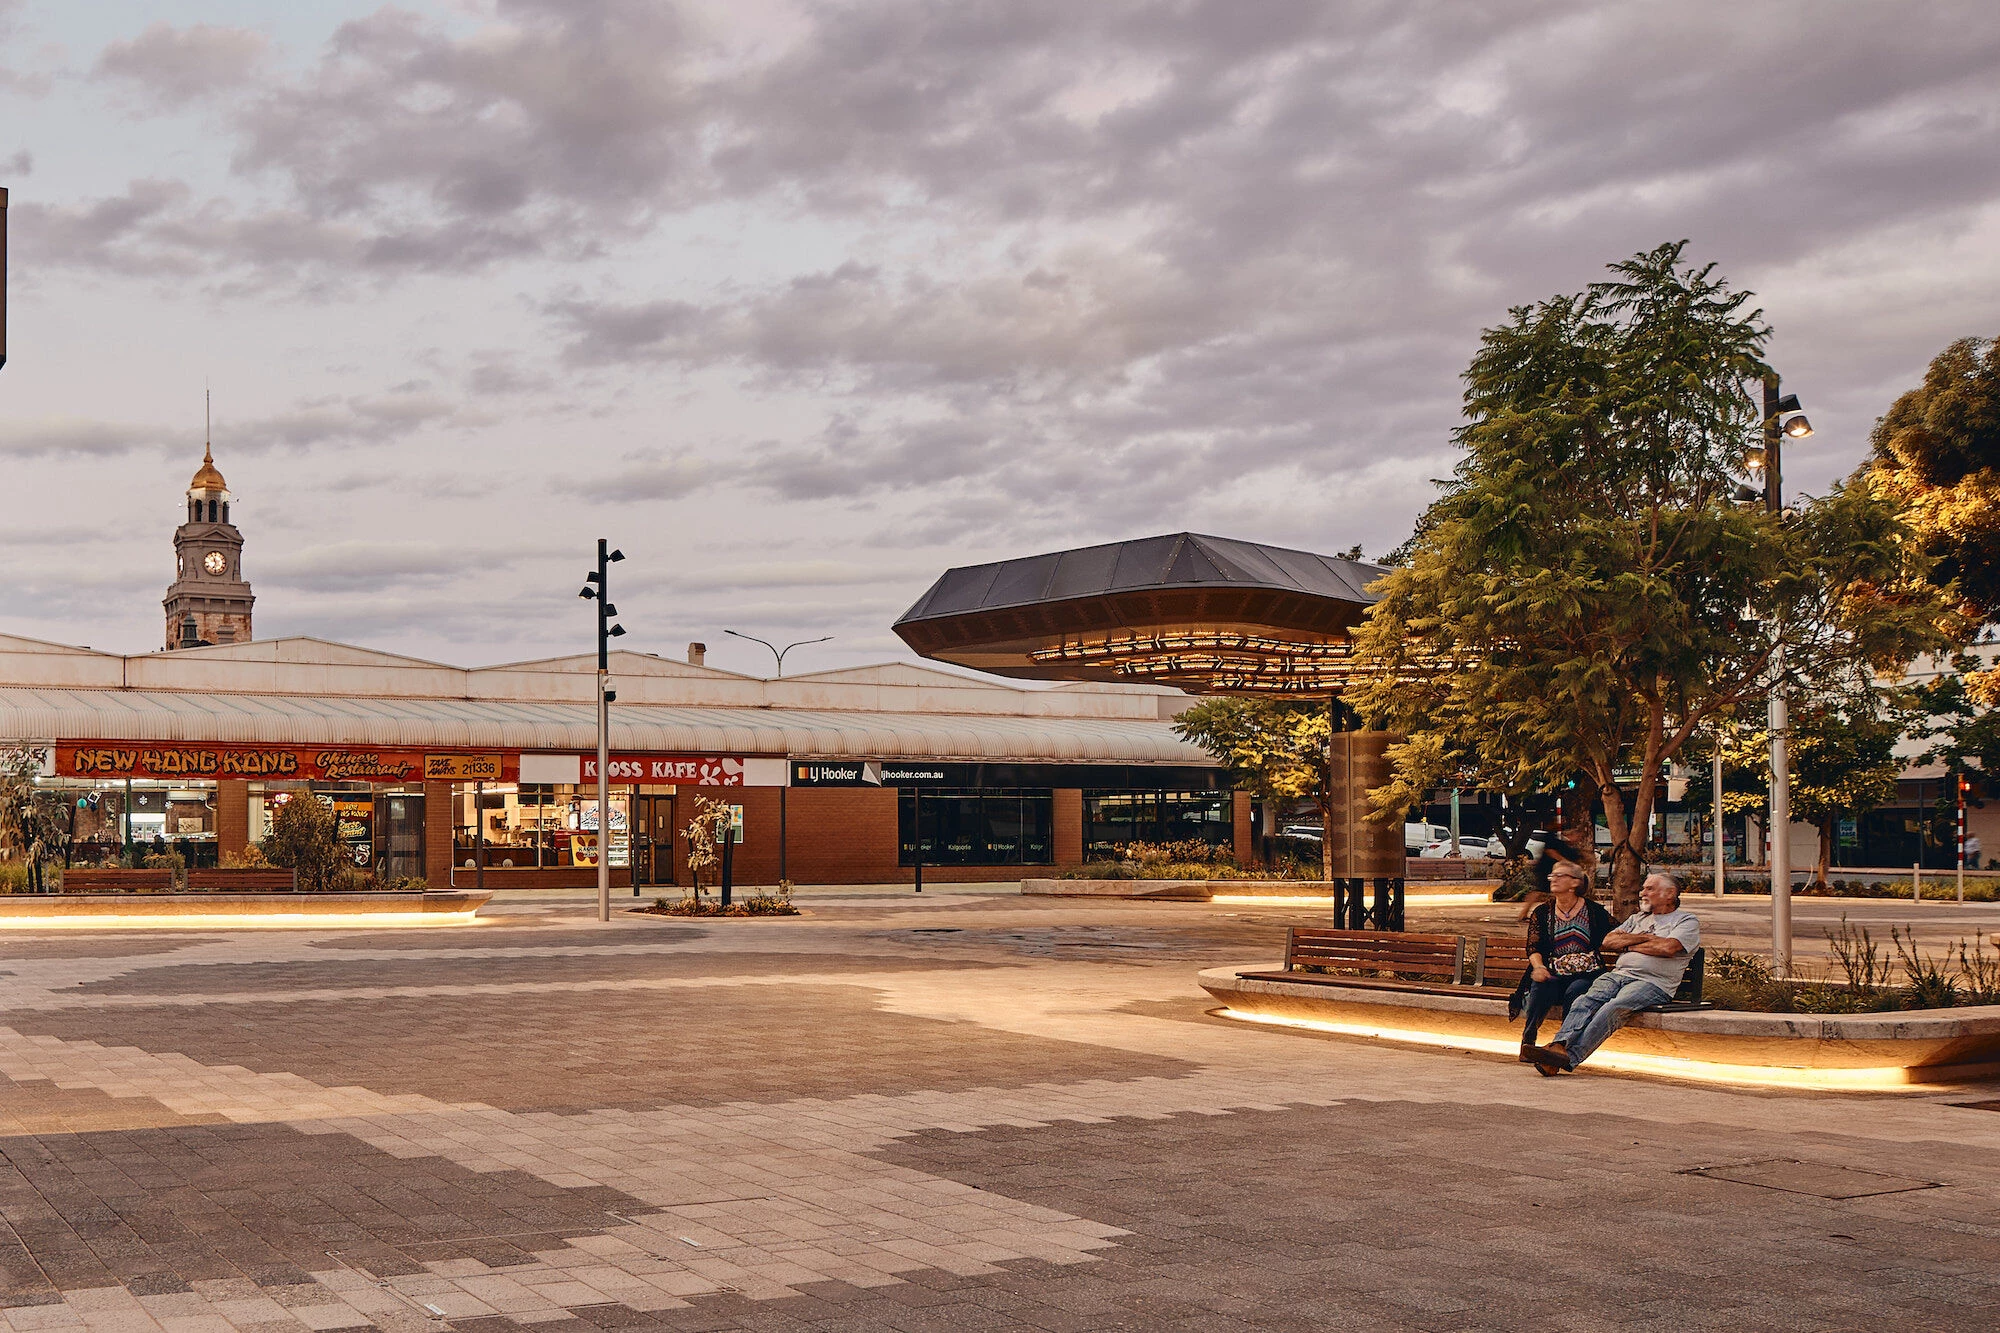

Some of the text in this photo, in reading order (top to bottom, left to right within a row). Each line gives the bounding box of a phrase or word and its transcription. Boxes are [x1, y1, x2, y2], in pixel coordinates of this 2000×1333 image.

[75, 749, 299, 774] NEW HONG KONG
[315, 751, 379, 768] Chinese
[429, 758, 452, 767] TAKE
[325, 761, 415, 779] Restaurant
[584, 761, 697, 778] KOSS KAFE
[810, 767, 857, 782] LJ Hooker
[880, 771, 944, 782] ljhooker.com.au
